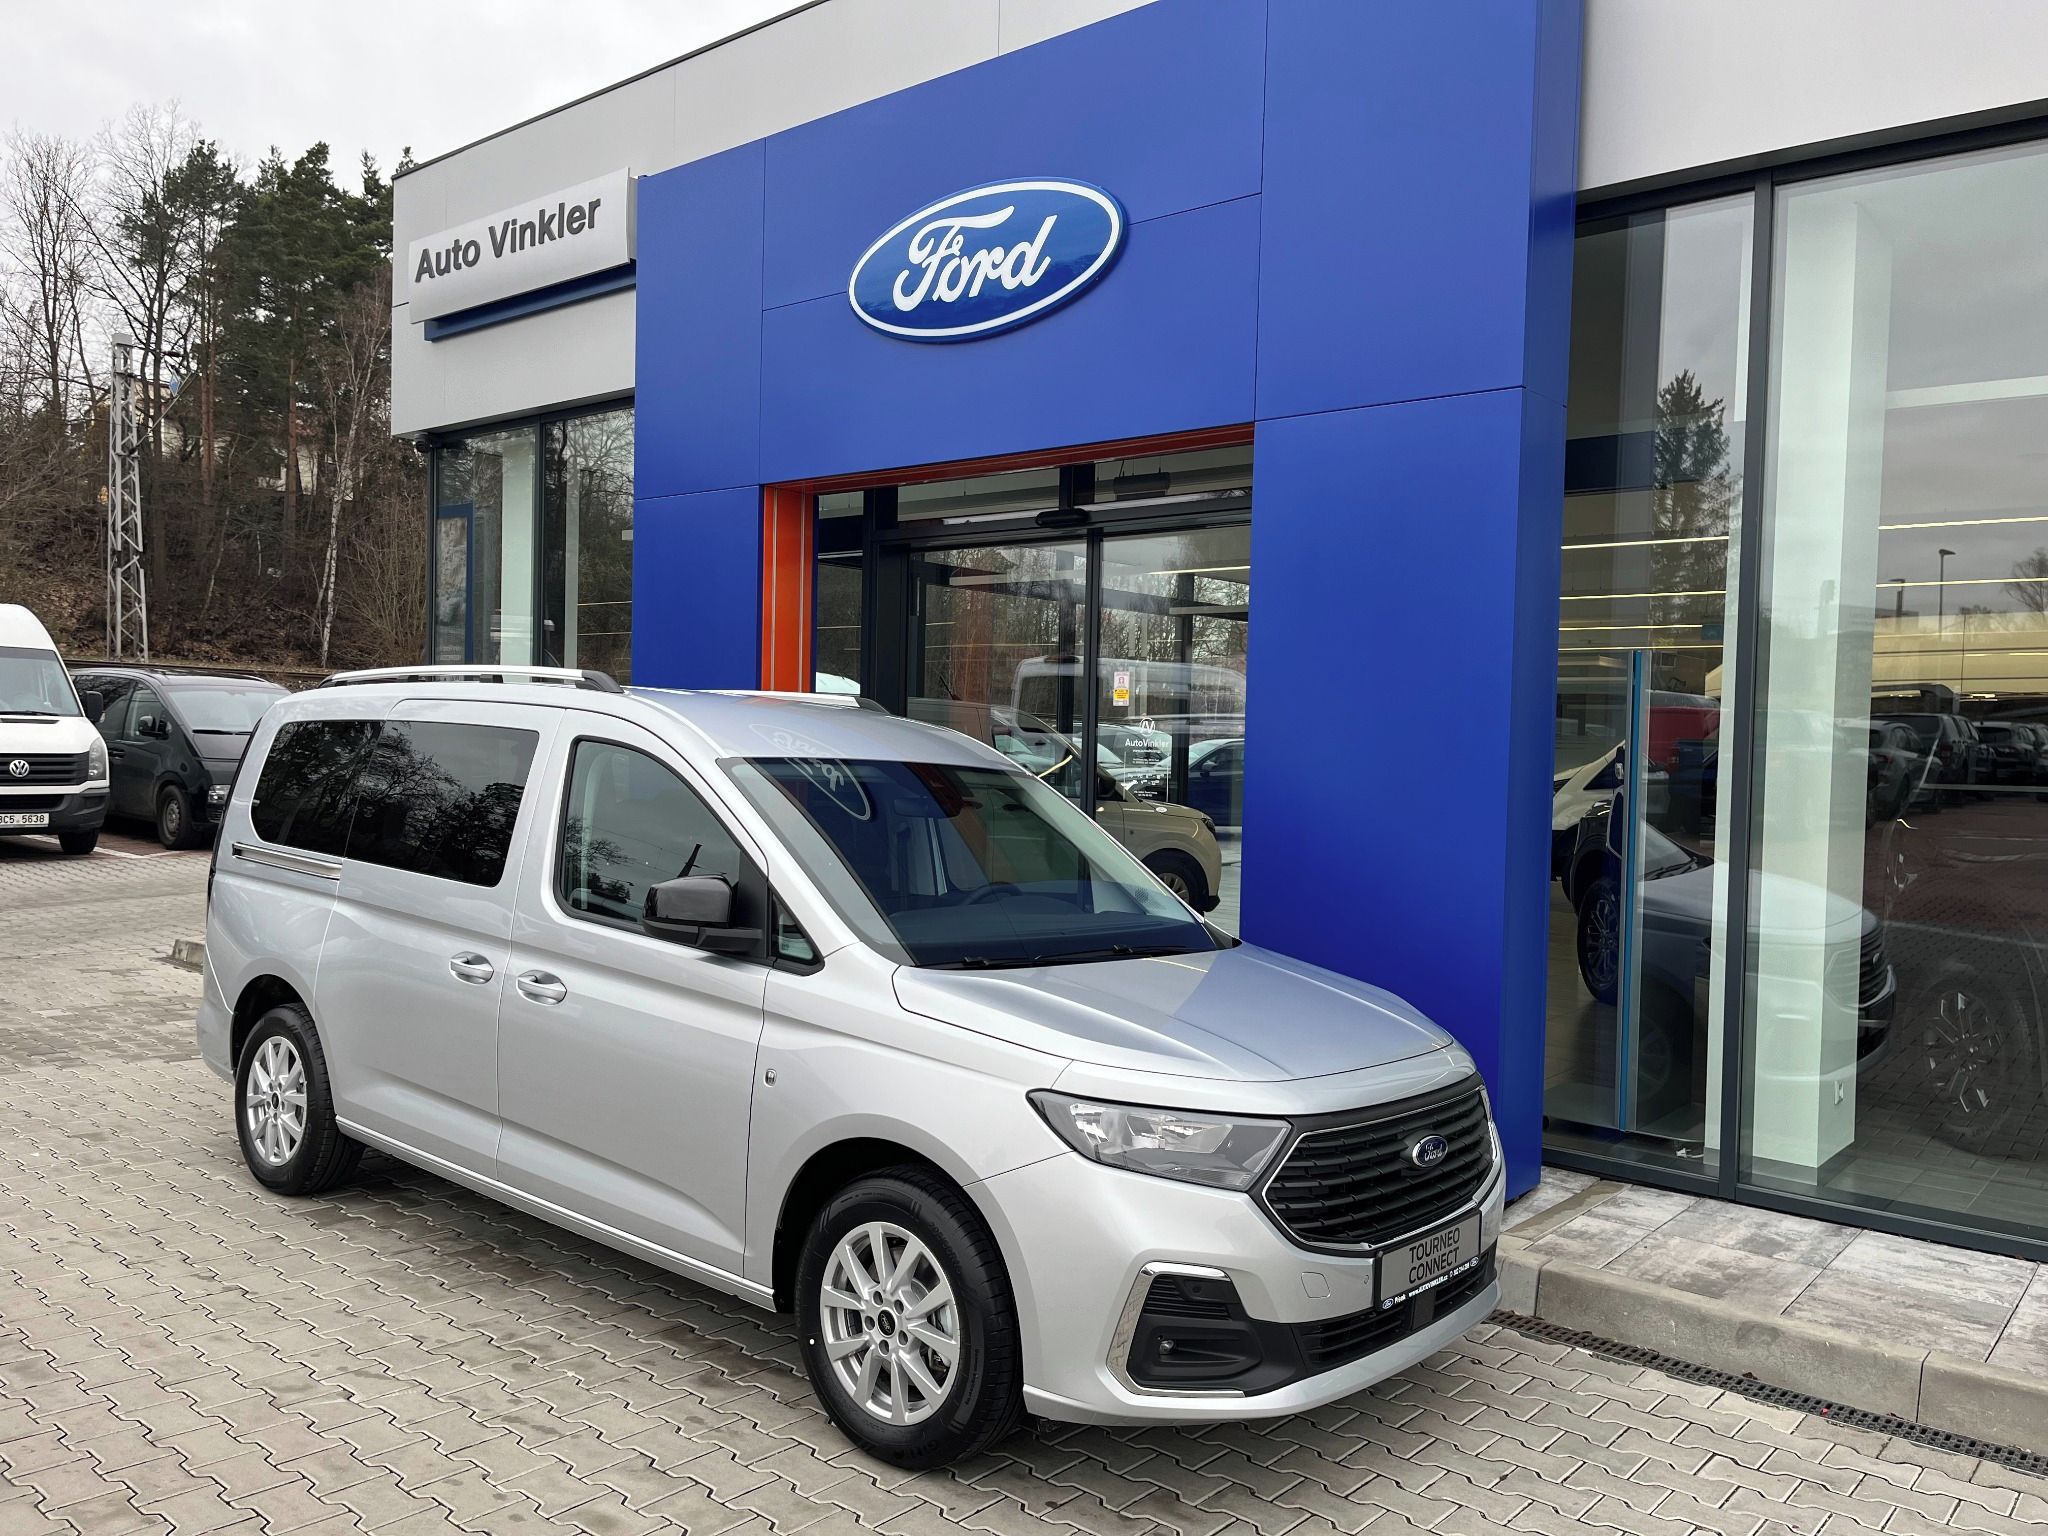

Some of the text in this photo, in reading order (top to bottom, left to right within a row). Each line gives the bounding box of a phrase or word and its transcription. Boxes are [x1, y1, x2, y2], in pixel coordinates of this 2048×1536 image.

[415, 198, 601, 283] Auto Vinkler
[893, 205, 1058, 312] Ford
[21, 814, 45, 823] 5638
[1409, 1227, 1460, 1264] TOURNEO
[1409, 1246, 1459, 1284] CONNECT
